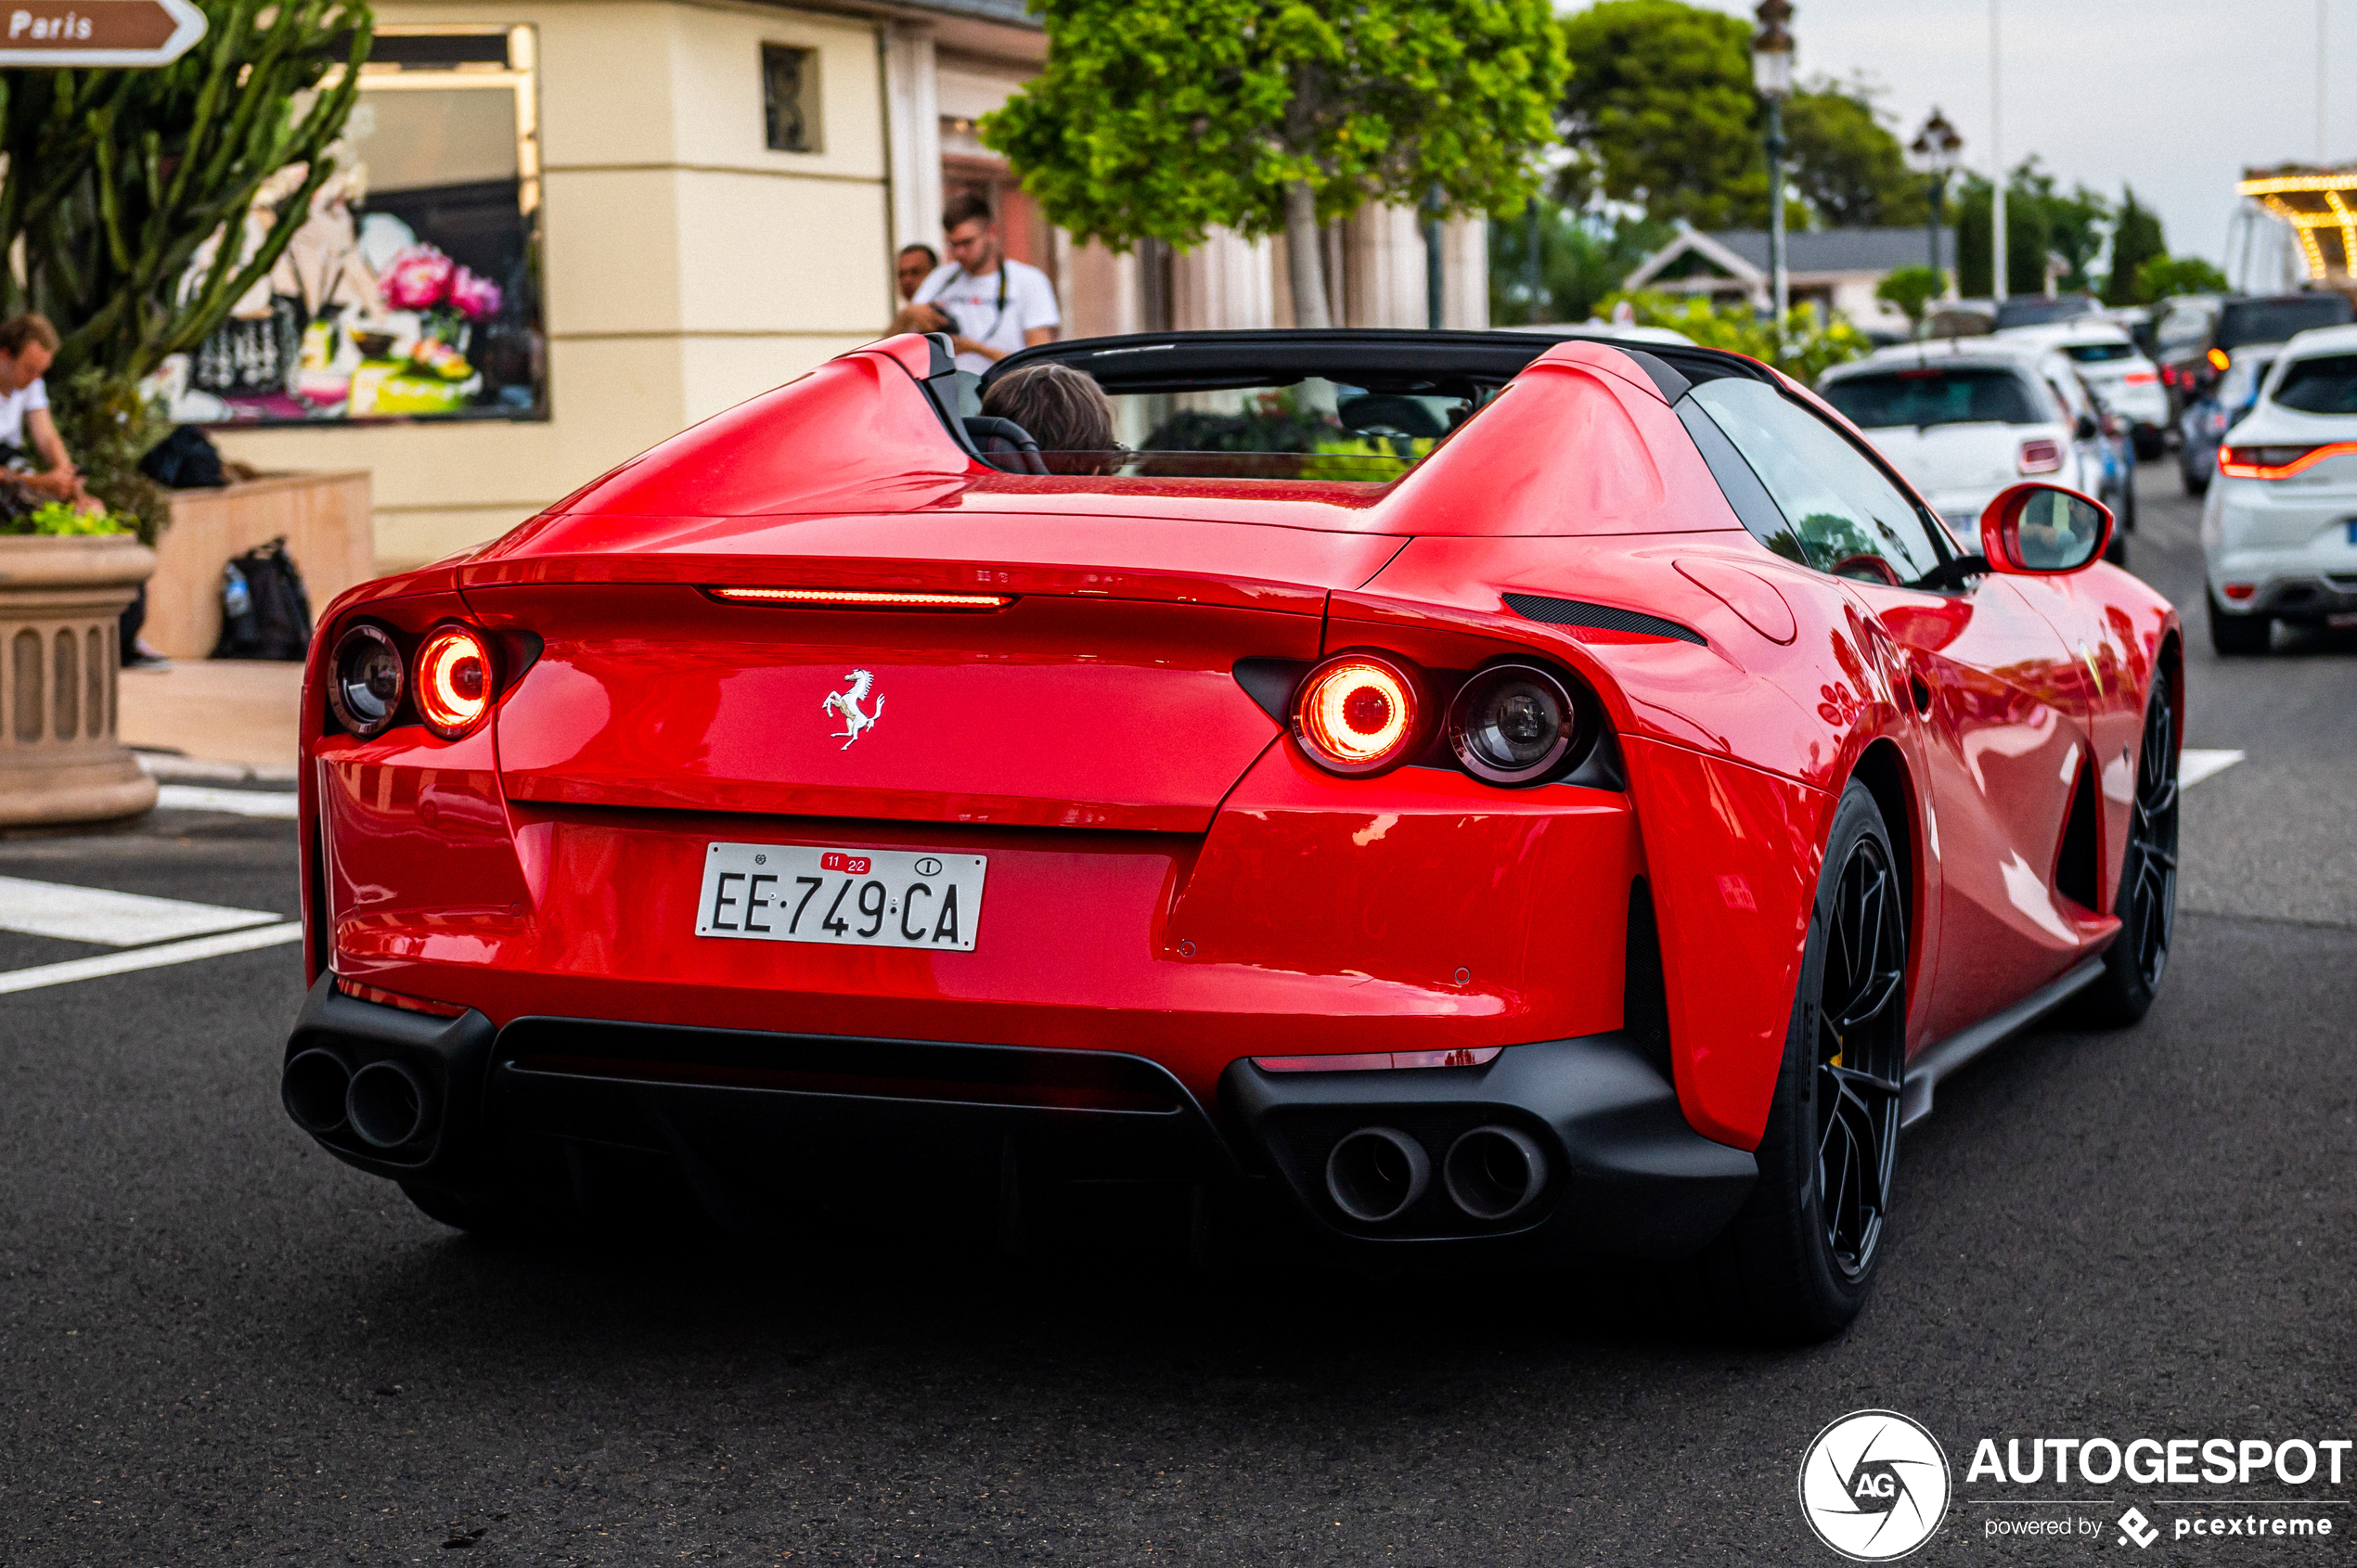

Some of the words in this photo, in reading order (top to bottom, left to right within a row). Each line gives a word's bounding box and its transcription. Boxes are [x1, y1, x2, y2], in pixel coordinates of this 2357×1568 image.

[8, 9, 93, 39] Paris
[828, 855, 840, 867] 11
[847, 859, 865, 872] 22
